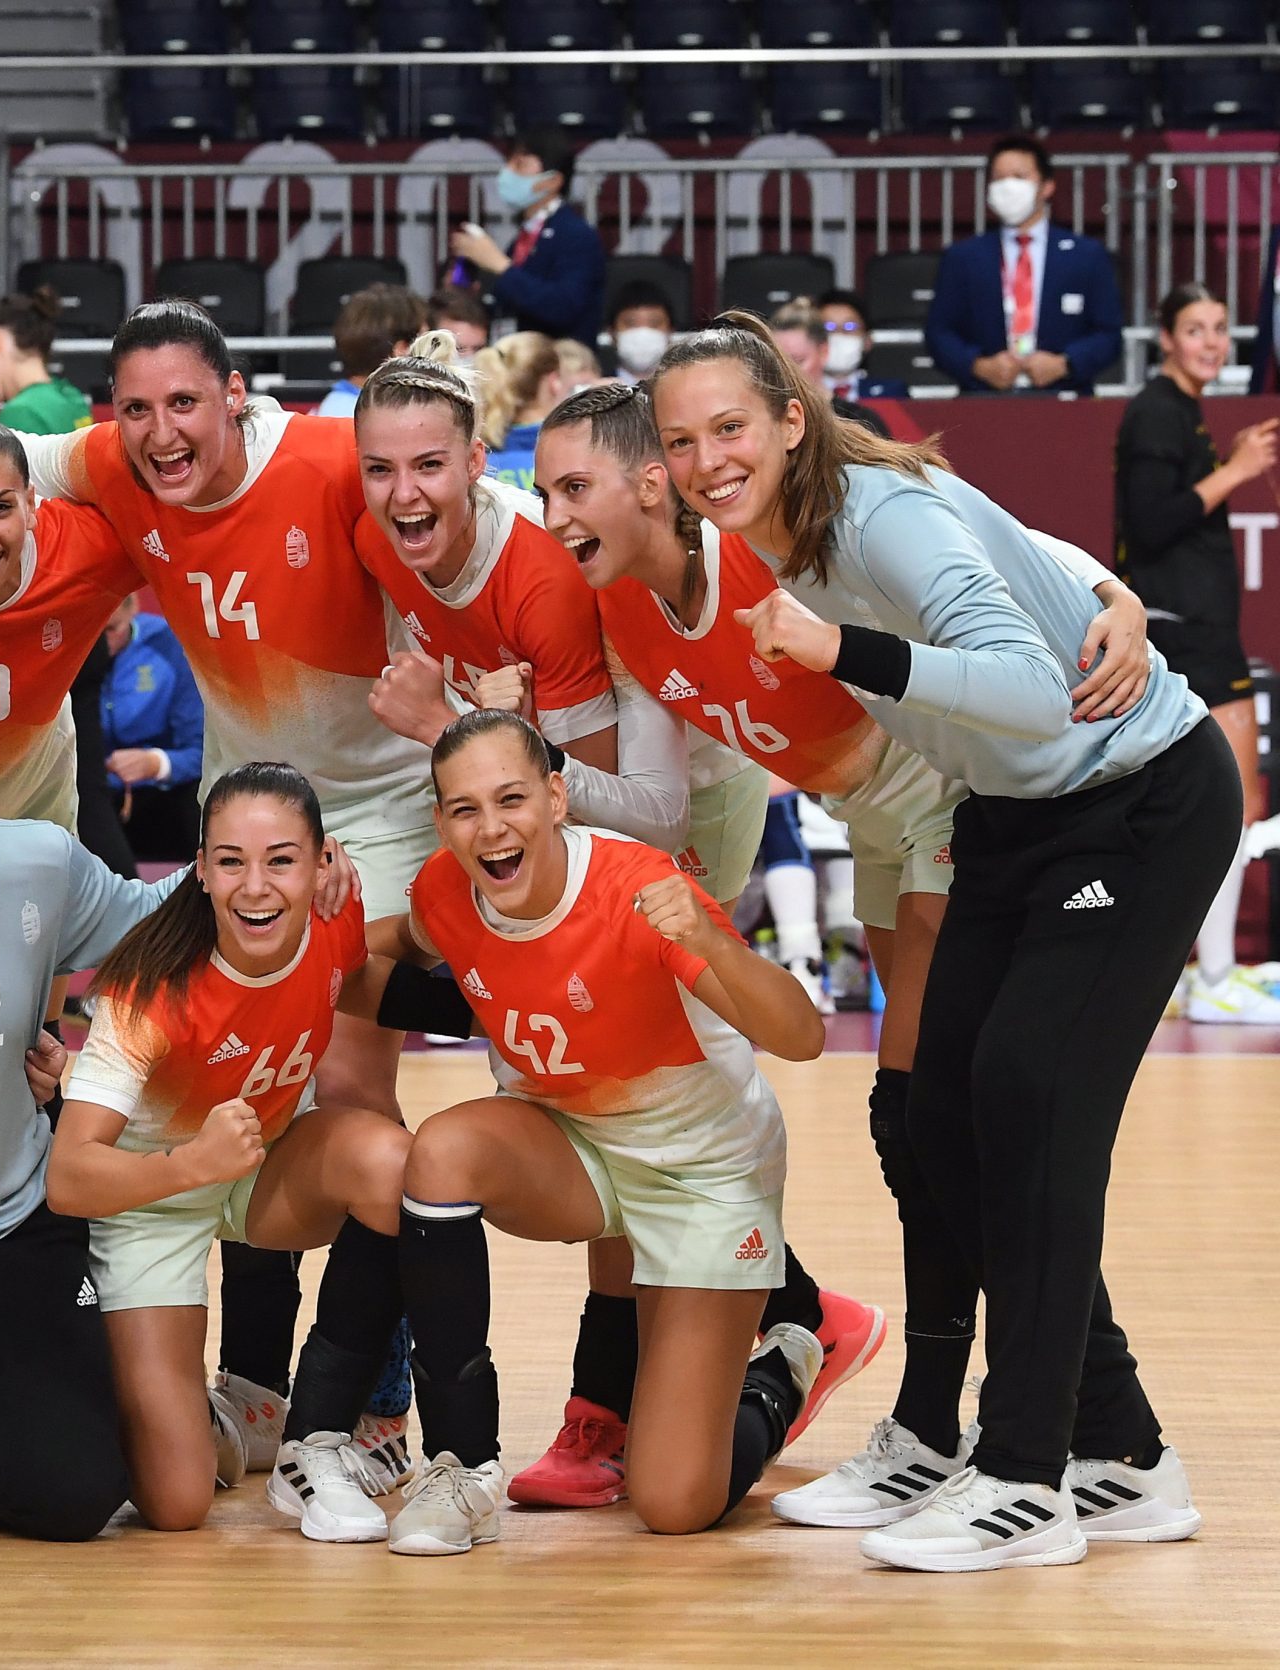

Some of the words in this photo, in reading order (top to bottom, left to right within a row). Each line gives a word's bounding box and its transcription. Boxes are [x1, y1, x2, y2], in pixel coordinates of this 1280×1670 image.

[186, 570, 261, 641] 14
[658, 687, 699, 701] adidas
[1062, 896, 1116, 910] adidas
[503, 1008, 587, 1075] 42
[206, 1044, 251, 1065] adidas
[236, 1028, 313, 1099] 66
[734, 1248, 769, 1260] adidas
